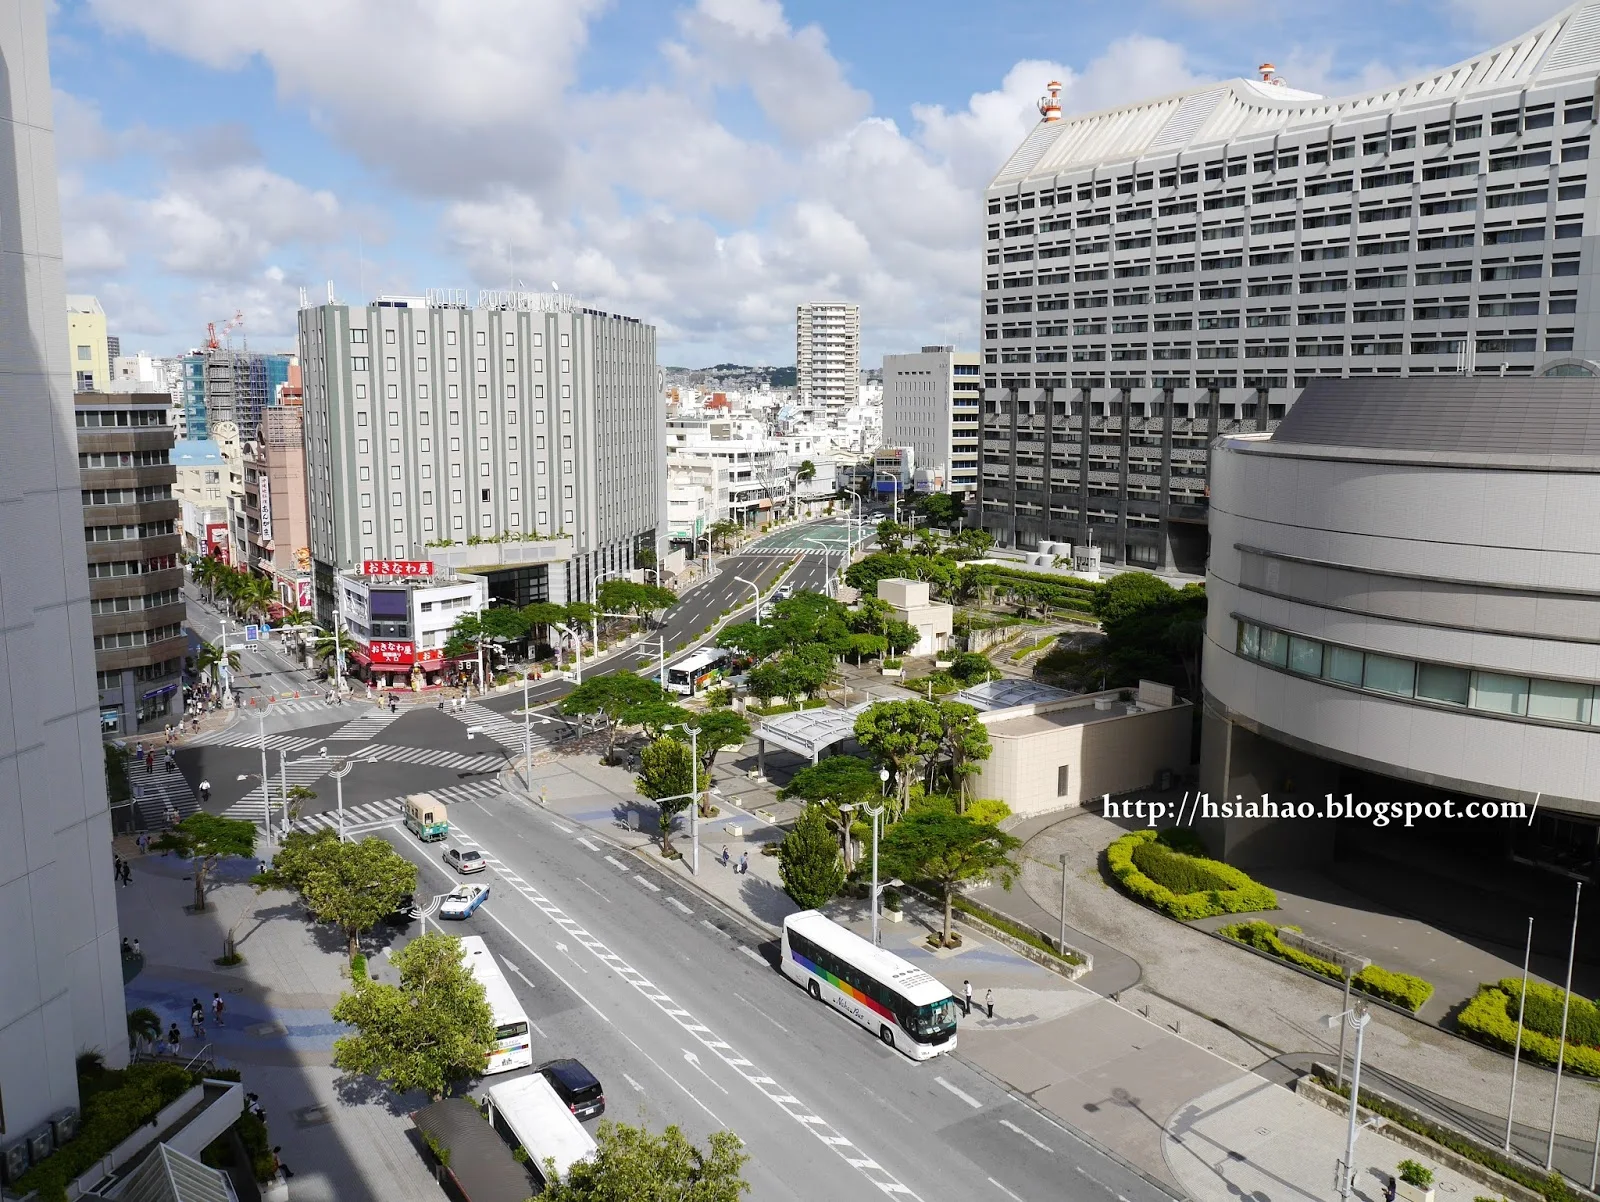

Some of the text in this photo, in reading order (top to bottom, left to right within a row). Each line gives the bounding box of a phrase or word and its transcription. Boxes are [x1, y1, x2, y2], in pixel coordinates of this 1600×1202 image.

[368, 562, 430, 575] おきなわ屋
[371, 642, 412, 655] おきなわ屋
